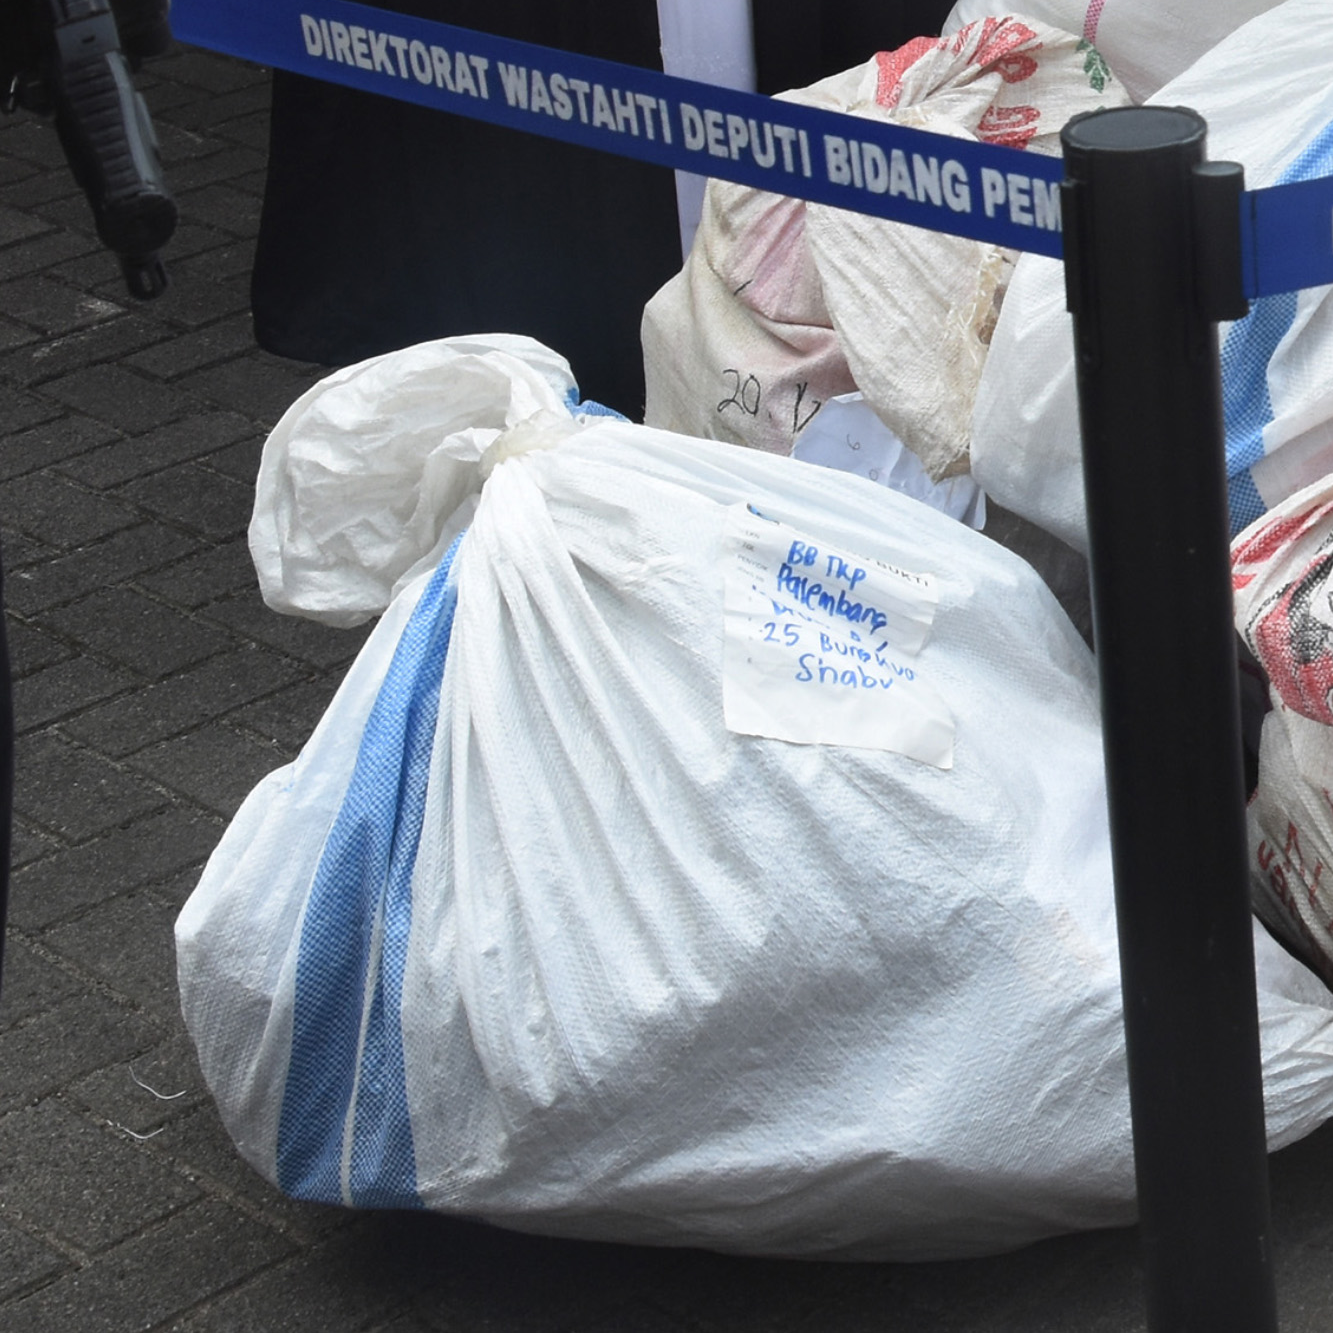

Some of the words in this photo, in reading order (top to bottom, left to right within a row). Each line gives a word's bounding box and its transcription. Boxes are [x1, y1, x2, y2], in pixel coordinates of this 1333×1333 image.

[299, 13, 490, 100] DIREKTORAT
[497, 61, 673, 145] WASTAHTI
[680, 102, 812, 178] DEPUTI
[824, 133, 972, 214] BIDANG
[981, 167, 1063, 233] PEM
[787, 539, 819, 567] BB
[763, 621, 824, 647] 25
